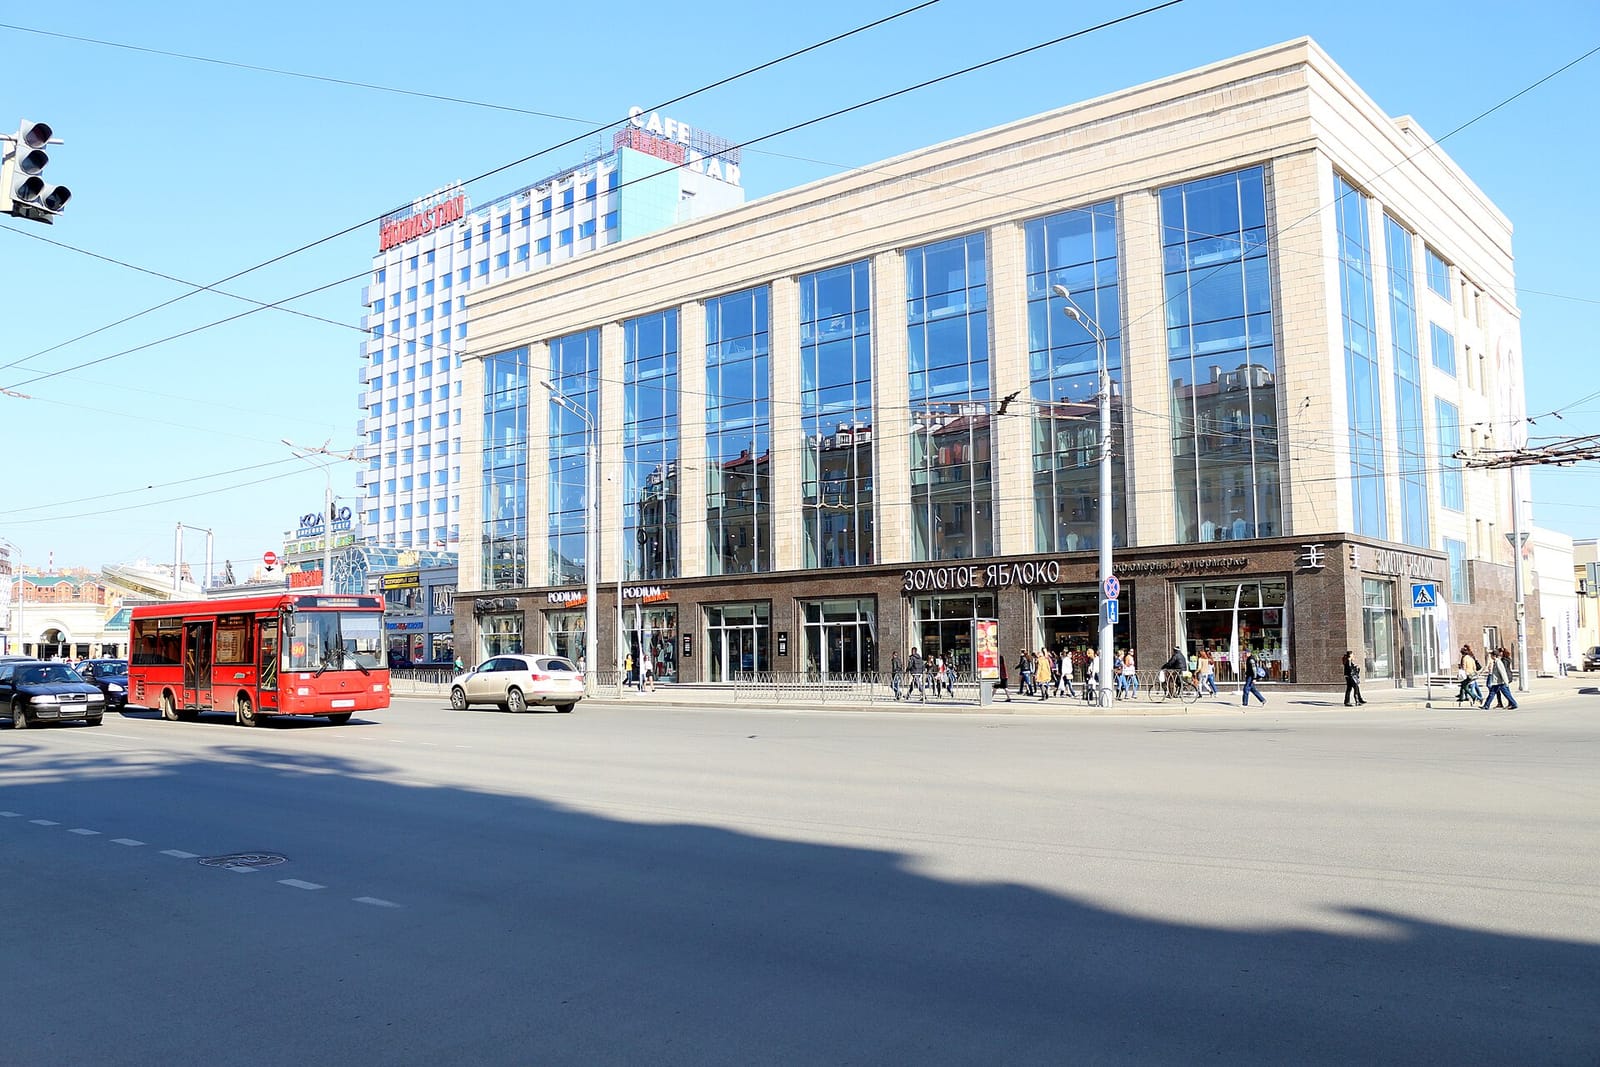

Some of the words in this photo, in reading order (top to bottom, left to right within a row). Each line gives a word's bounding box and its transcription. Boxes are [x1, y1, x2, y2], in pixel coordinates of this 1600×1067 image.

[628, 105, 691, 146] CAFE
[689, 150, 741, 187] BAR
[904, 566, 979, 591] ЗОЛОТОЕ
[987, 560, 1060, 586] ЯБЛОКО
[547, 591, 582, 603] PODIUM
[623, 586, 661, 598] PODIUM
